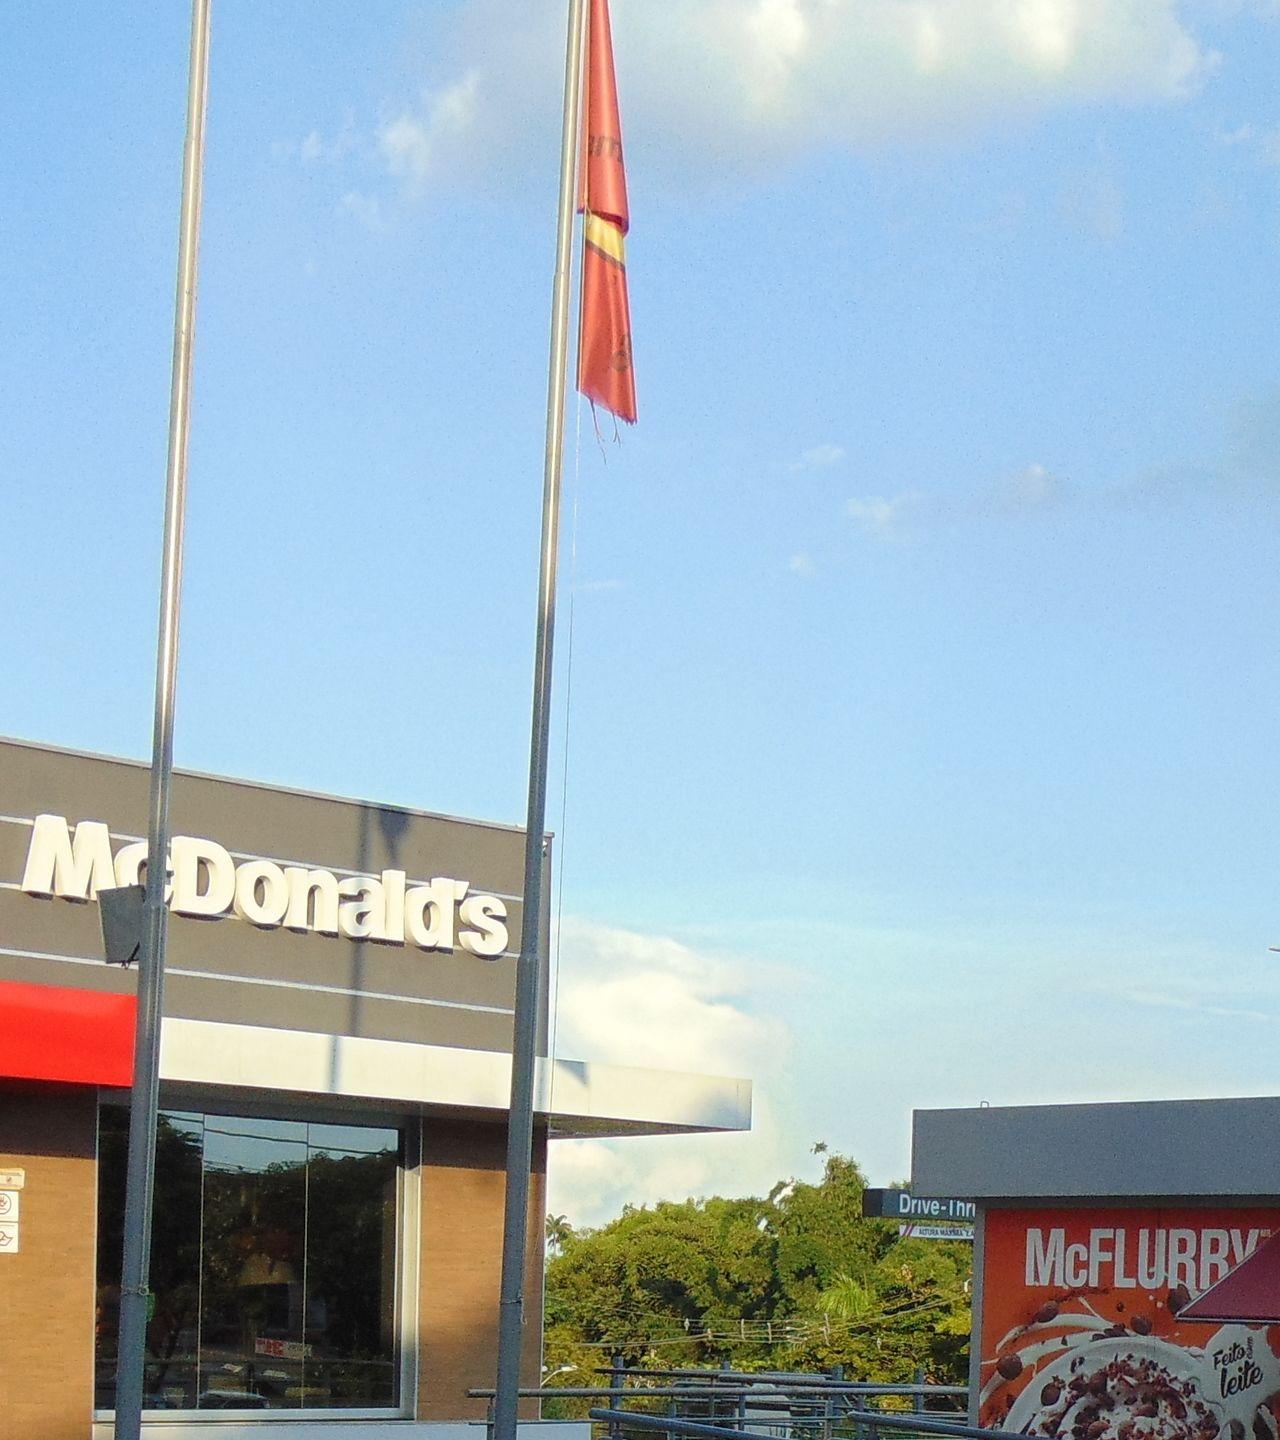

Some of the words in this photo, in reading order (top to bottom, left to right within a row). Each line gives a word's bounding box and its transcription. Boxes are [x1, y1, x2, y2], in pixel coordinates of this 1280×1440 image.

[21, 814, 509, 958] McDonald's
[1025, 1228, 1260, 1290] McFLURRY
[1213, 1342, 1246, 1370] Feito
[1221, 1360, 1263, 1398] leite
